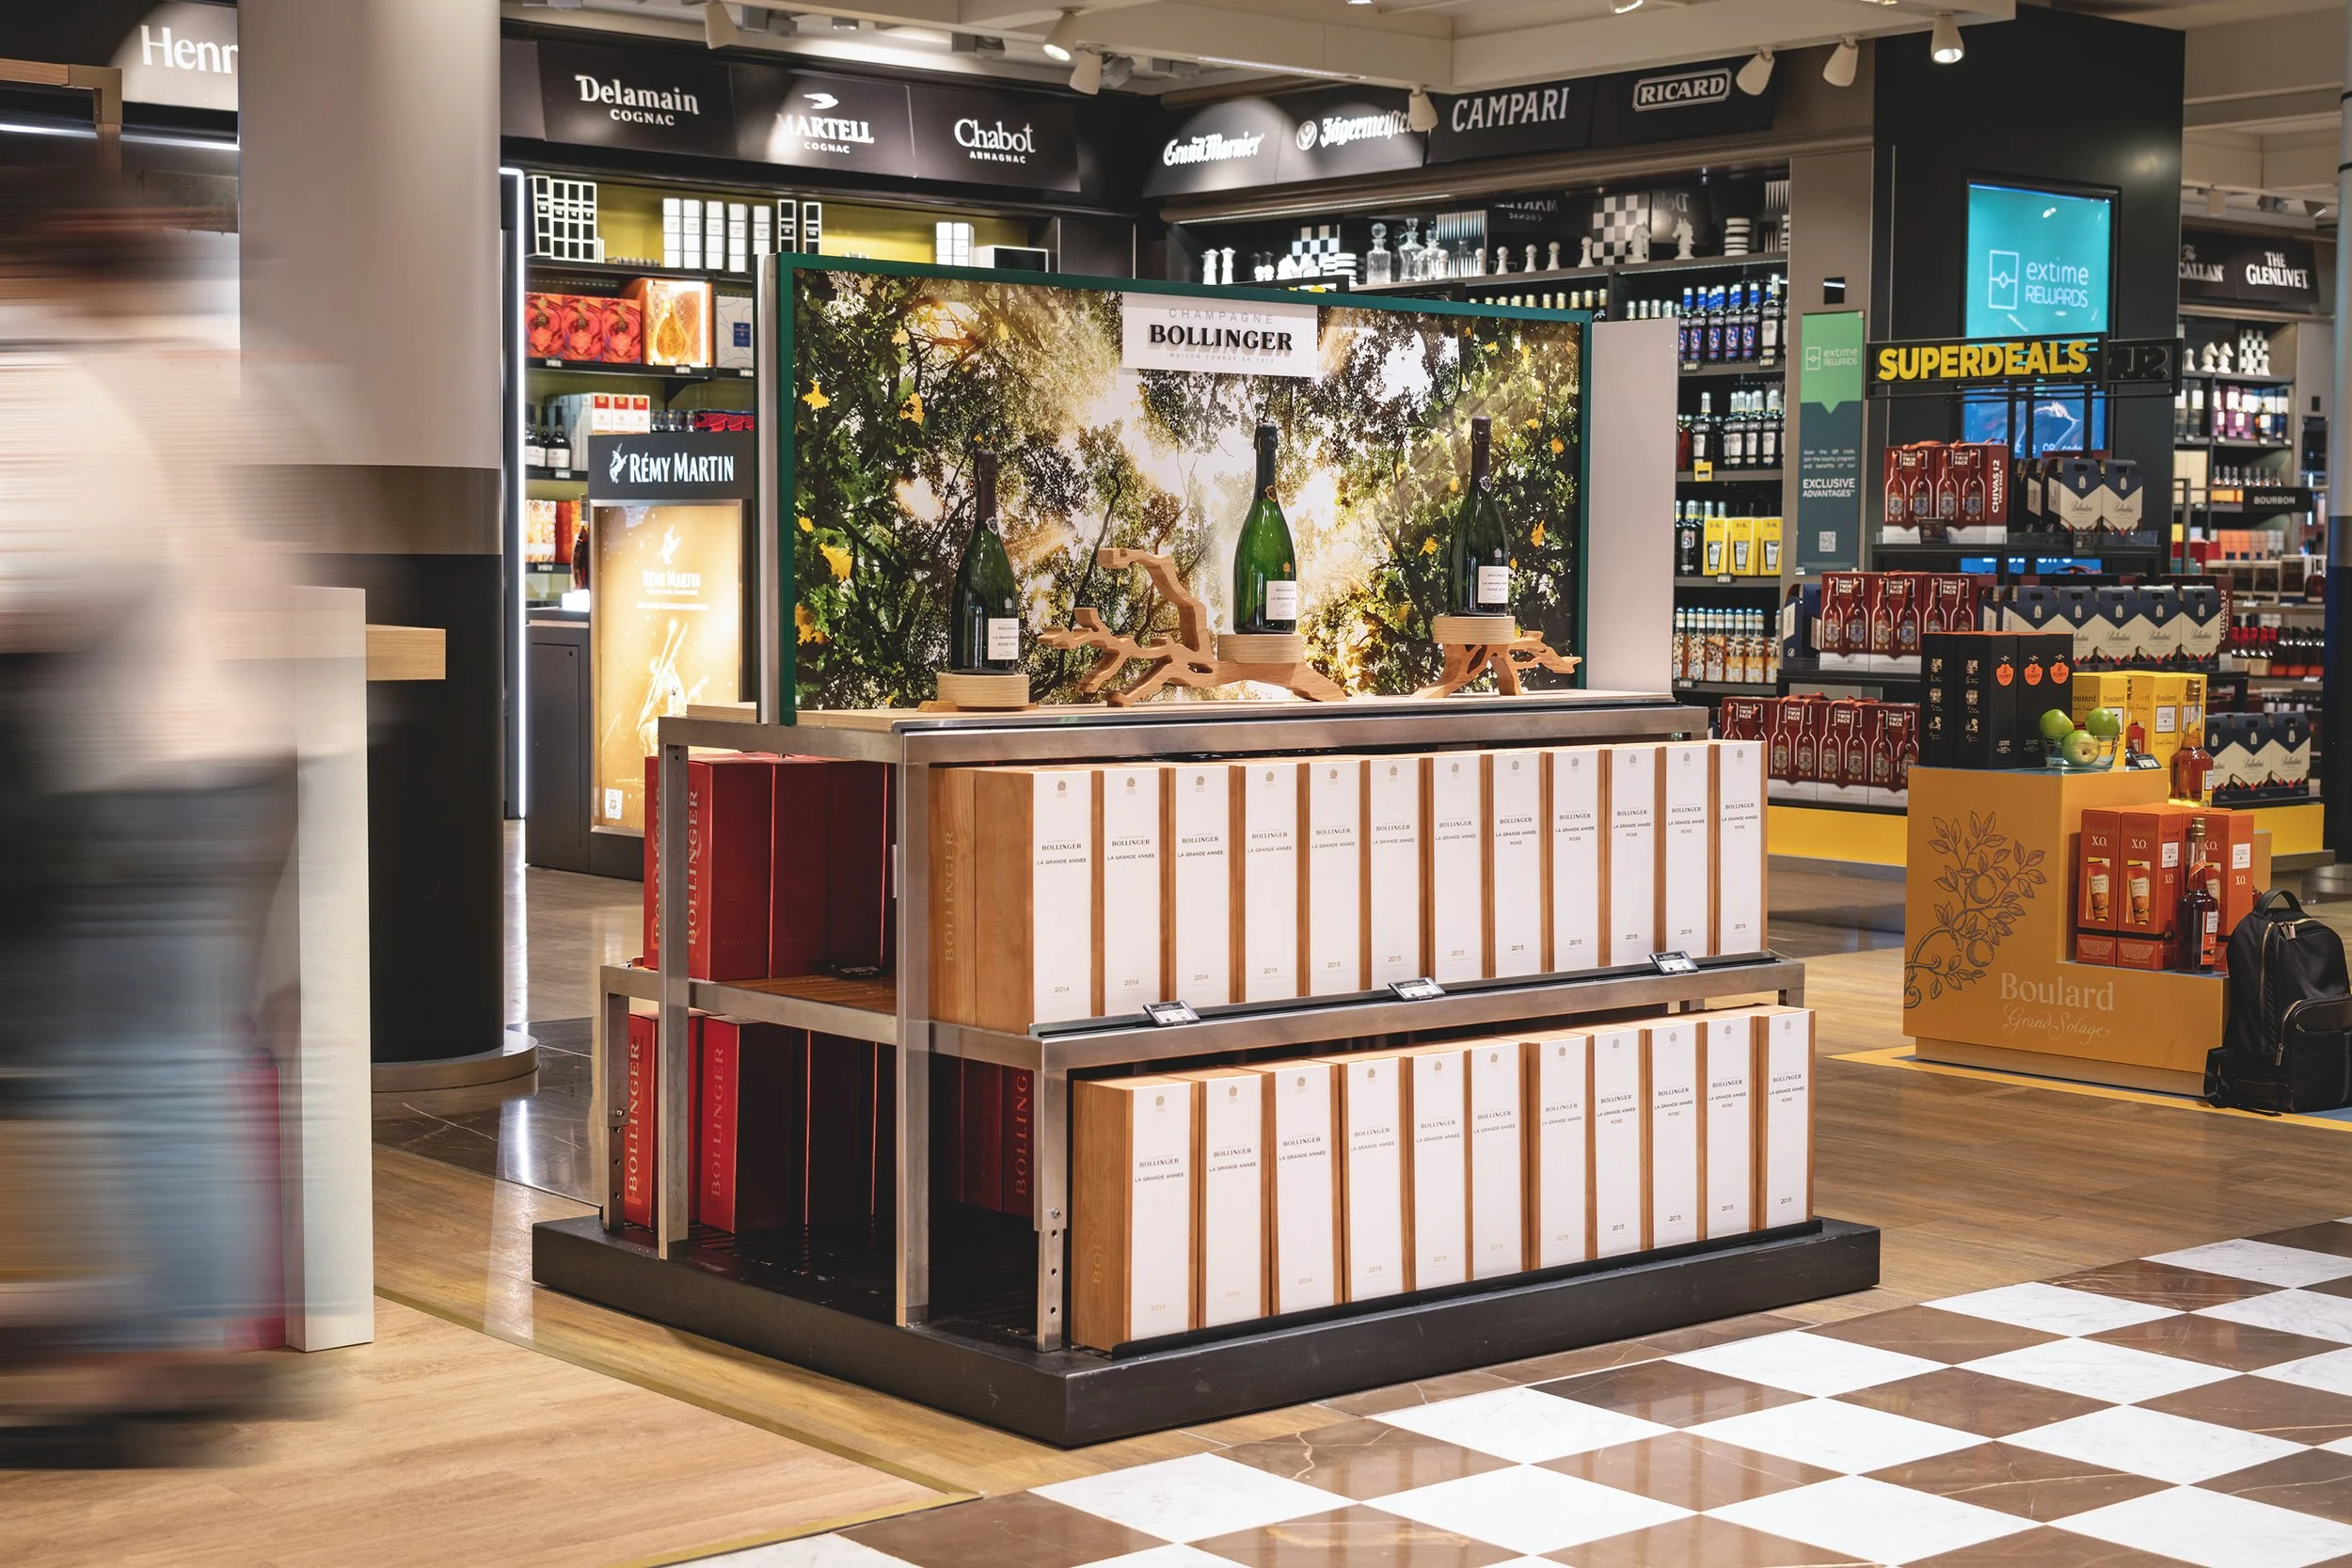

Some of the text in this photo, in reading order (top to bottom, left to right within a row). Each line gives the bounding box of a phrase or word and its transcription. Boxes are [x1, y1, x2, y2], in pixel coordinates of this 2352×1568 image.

[574, 74, 700, 115] Delamain
[1640, 77, 1726, 104] RICARD
[610, 108, 675, 126] COGNAC
[1452, 87, 1570, 133] CAMPARI
[775, 113, 875, 144] MARTELL
[954, 119, 1036, 152] Chabot
[803, 142, 850, 154] COGNAC
[1204, 132, 1263, 162] Marnier
[970, 150, 1026, 164] ARMAGNAC
[2265, 251, 2287, 269] THE
[2026, 257, 2090, 285] extime
[2246, 263, 2309, 289] GLENLIVET
[2025, 285, 2089, 309] REWARDS
[1168, 309, 1274, 325] CHAMPAGNE
[1150, 325, 1293, 351] BOLLINGER
[1824, 346, 1858, 357] extime
[1878, 341, 2090, 381] SUPERDEALS
[629, 452, 734, 483] RÉMY MARTIN
[1803, 478, 1855, 489] EXCLUSIVE
[1992, 460, 2000, 513] CHIVAS 12
[2253, 496, 2296, 504] BOURBON
[2220, 590, 2227, 600] 12
[1252, 831, 1287, 839] BOLLINGER
[2091, 835, 2107, 847] X.O.
[2131, 838, 2148, 849] X.O.
[689, 791, 699, 945] BOLLINGER
[946, 832, 955, 961] BOLLINGER
[2000, 972, 2115, 1011] Boulard
[2003, 1004, 2110, 1045] Grand Solage
[1773, 1074, 1802, 1083] BOLLINGER
[1601, 1095, 1631, 1103] BOLLINGER
[1659, 1087, 1689, 1096] BOLLINGER
[1478, 1109, 1511, 1120] BOLLINGER
[1546, 1102, 1578, 1112] BOLLINGER
[628, 1044, 640, 1192] BOLLINGER
[711, 1048, 723, 1196] BOLLINGER
[1421, 1120, 1455, 1129] BOLLINGER
[1355, 1128, 1390, 1137] BOLLINGER
[1283, 1137, 1320, 1147] BOLLINGER
[1214, 1147, 1251, 1157] BOLLINGER
[1140, 1158, 1179, 1167] BOLLINGER
